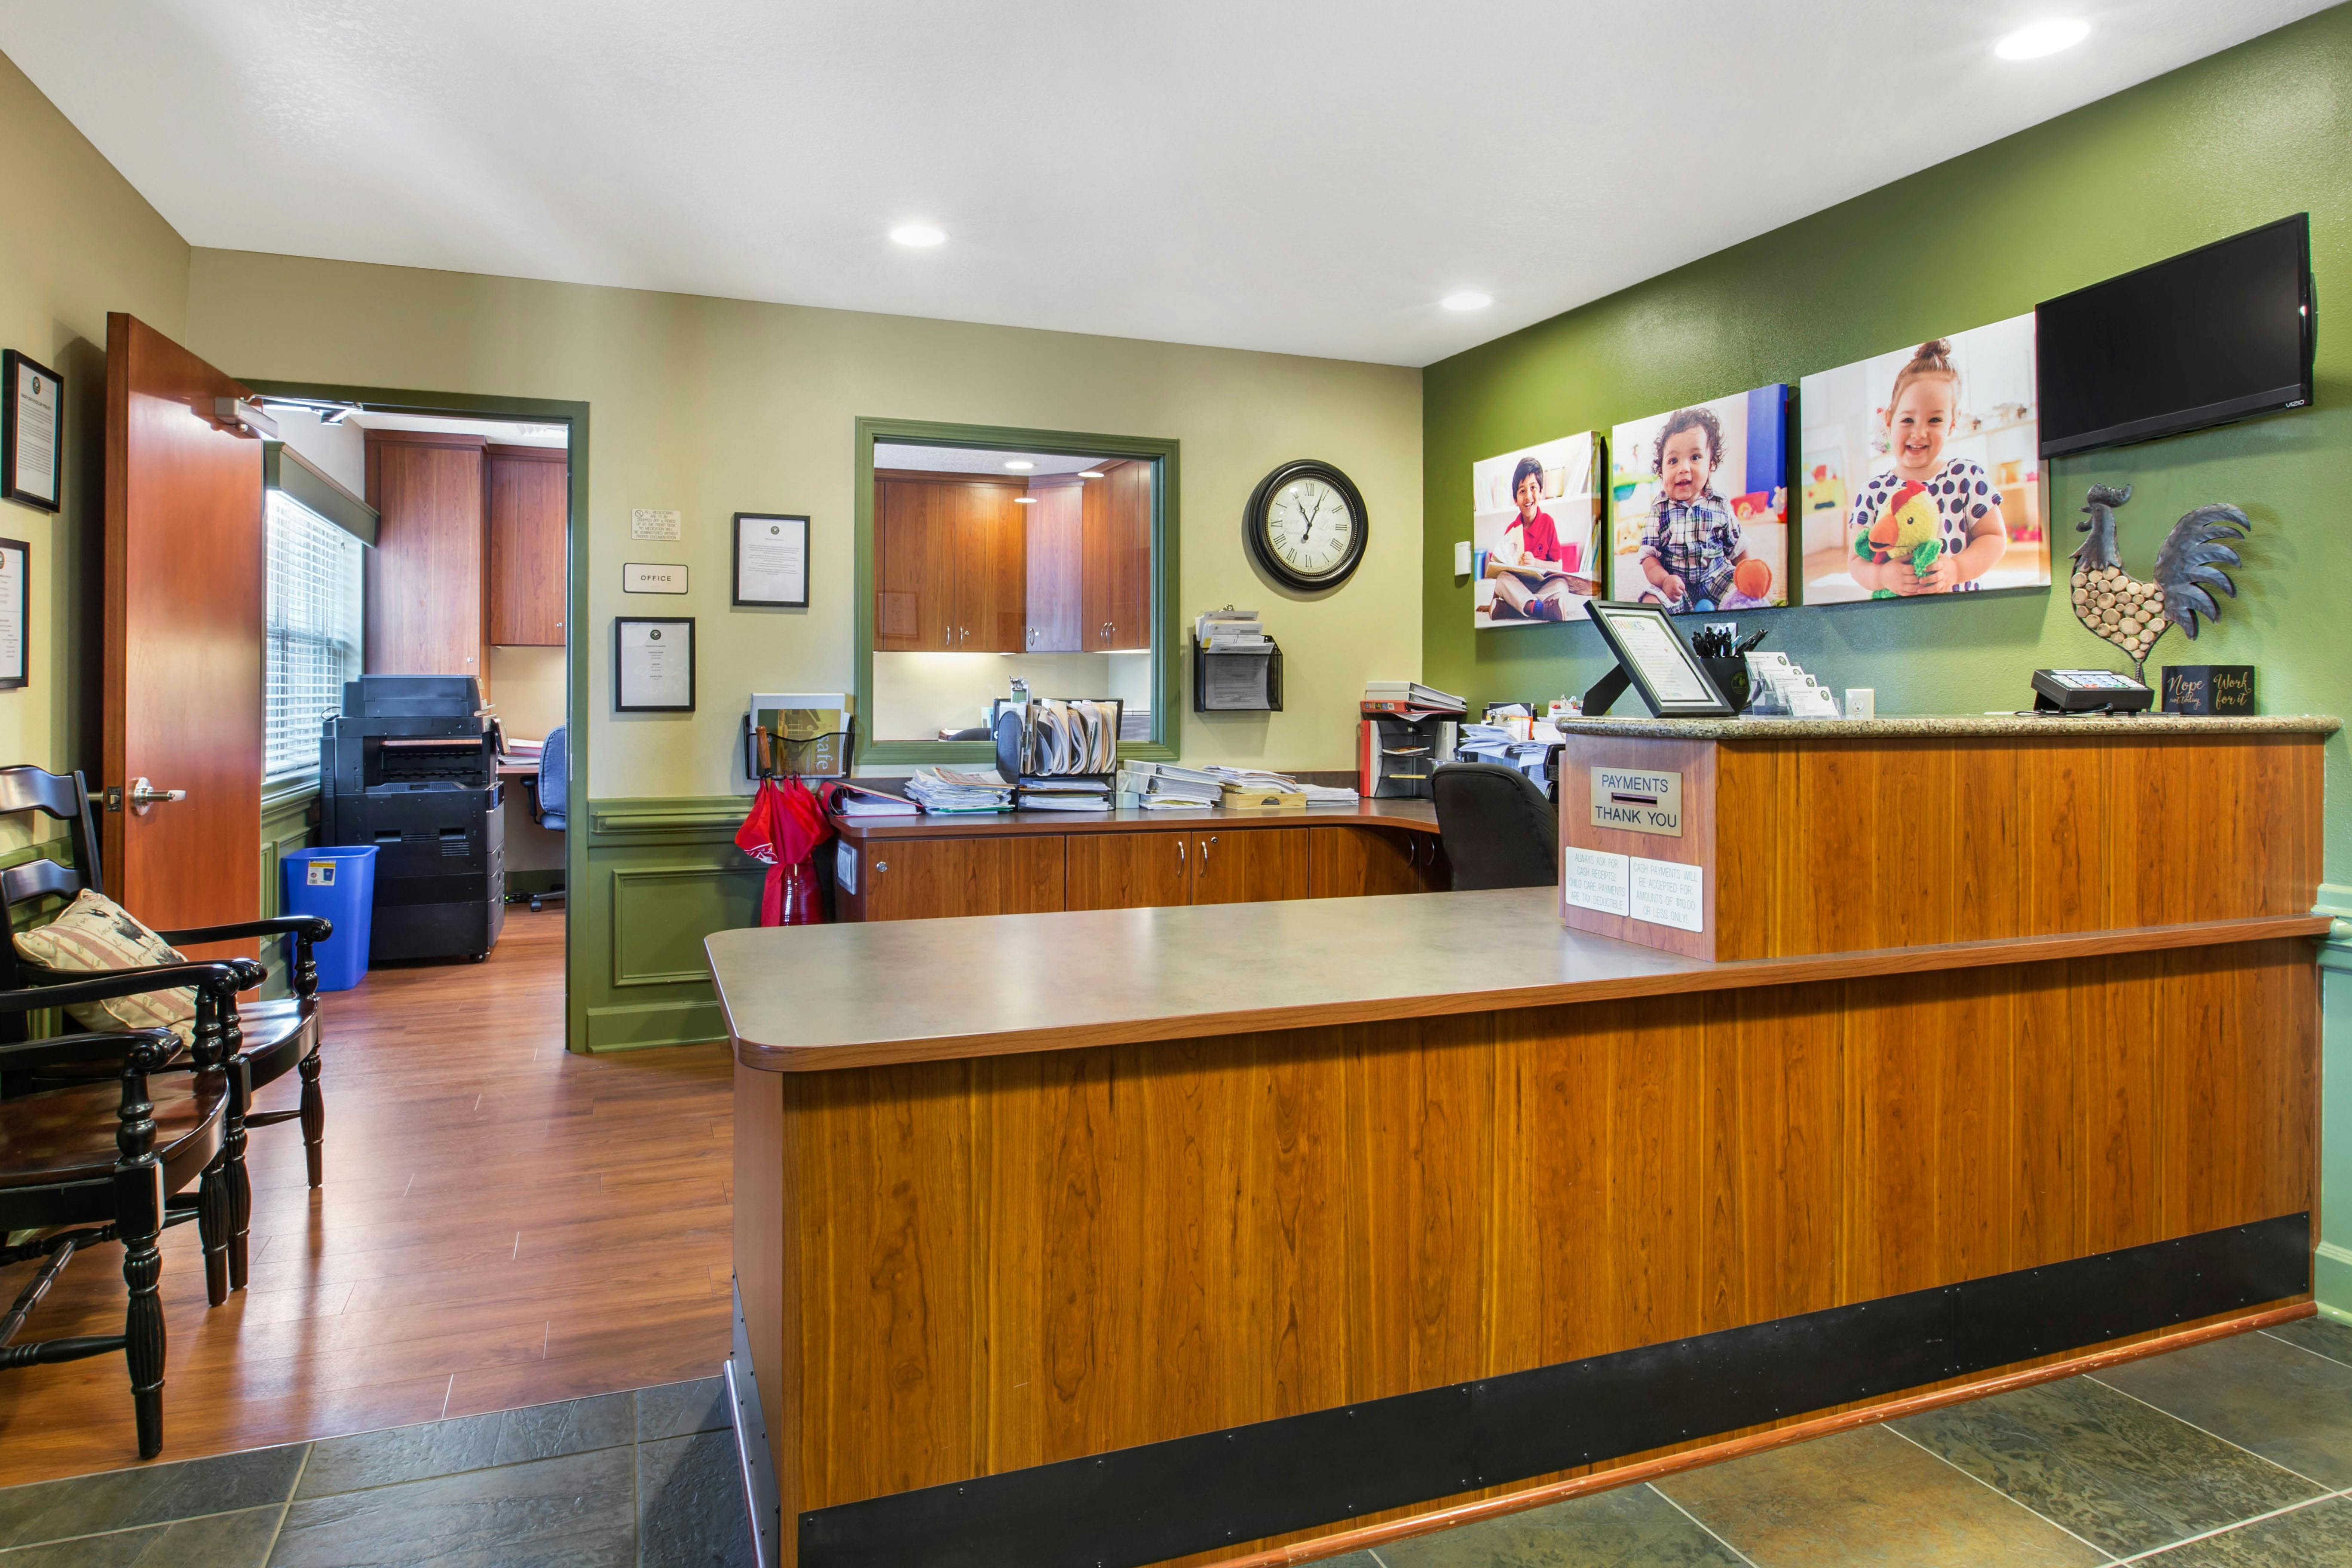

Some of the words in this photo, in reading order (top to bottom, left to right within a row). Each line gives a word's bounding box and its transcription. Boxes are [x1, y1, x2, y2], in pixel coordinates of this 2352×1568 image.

[2285, 399, 2304, 408] VIZIO
[2167, 674, 2205, 697] Nope
[2214, 671, 2252, 693] Work
[2180, 694, 2201, 710] today
[2216, 689, 2235, 710] for
[2237, 692, 2250, 706] it
[816, 735, 833, 770] safe
[1602, 775, 1668, 793] PAYMENTS
[1595, 806, 1641, 824] THANK
[1648, 811, 1677, 828] YOU
[1575, 853, 1594, 865] ALWAYS
[1596, 857, 1606, 867] ASK
[1608, 858, 1618, 869] FOR
[1577, 866, 1589, 877] CASH
[1592, 869, 1616, 882] RECEIPTS!
[1633, 863, 1648, 873] CASH
[1651, 865, 1681, 879] PAYMENTS
[1684, 870, 1698, 882] WILL
[1568, 877, 1582, 888] CHILD
[1584, 881, 1596, 891] CARE
[1598, 883, 1626, 897] PAYMENTS
[1639, 877, 1646, 888] BE
[1648, 879, 1677, 893] ACCEPTED
[1680, 884, 1692, 895] FOR
[1571, 891, 1580, 901] ARE
[1582, 893, 1591, 903] TAX
[1593, 895, 1623, 910] DEDUCTIBLE
[1636, 890, 1663, 905] AMOUNTS
[1665, 895, 1674, 906] OF
[1676, 897, 1695, 911] $10.00
[1644, 905, 1651, 915] OR
[1653, 907, 1668, 919] LESS
[1671, 911, 1689, 924] ONLY!
